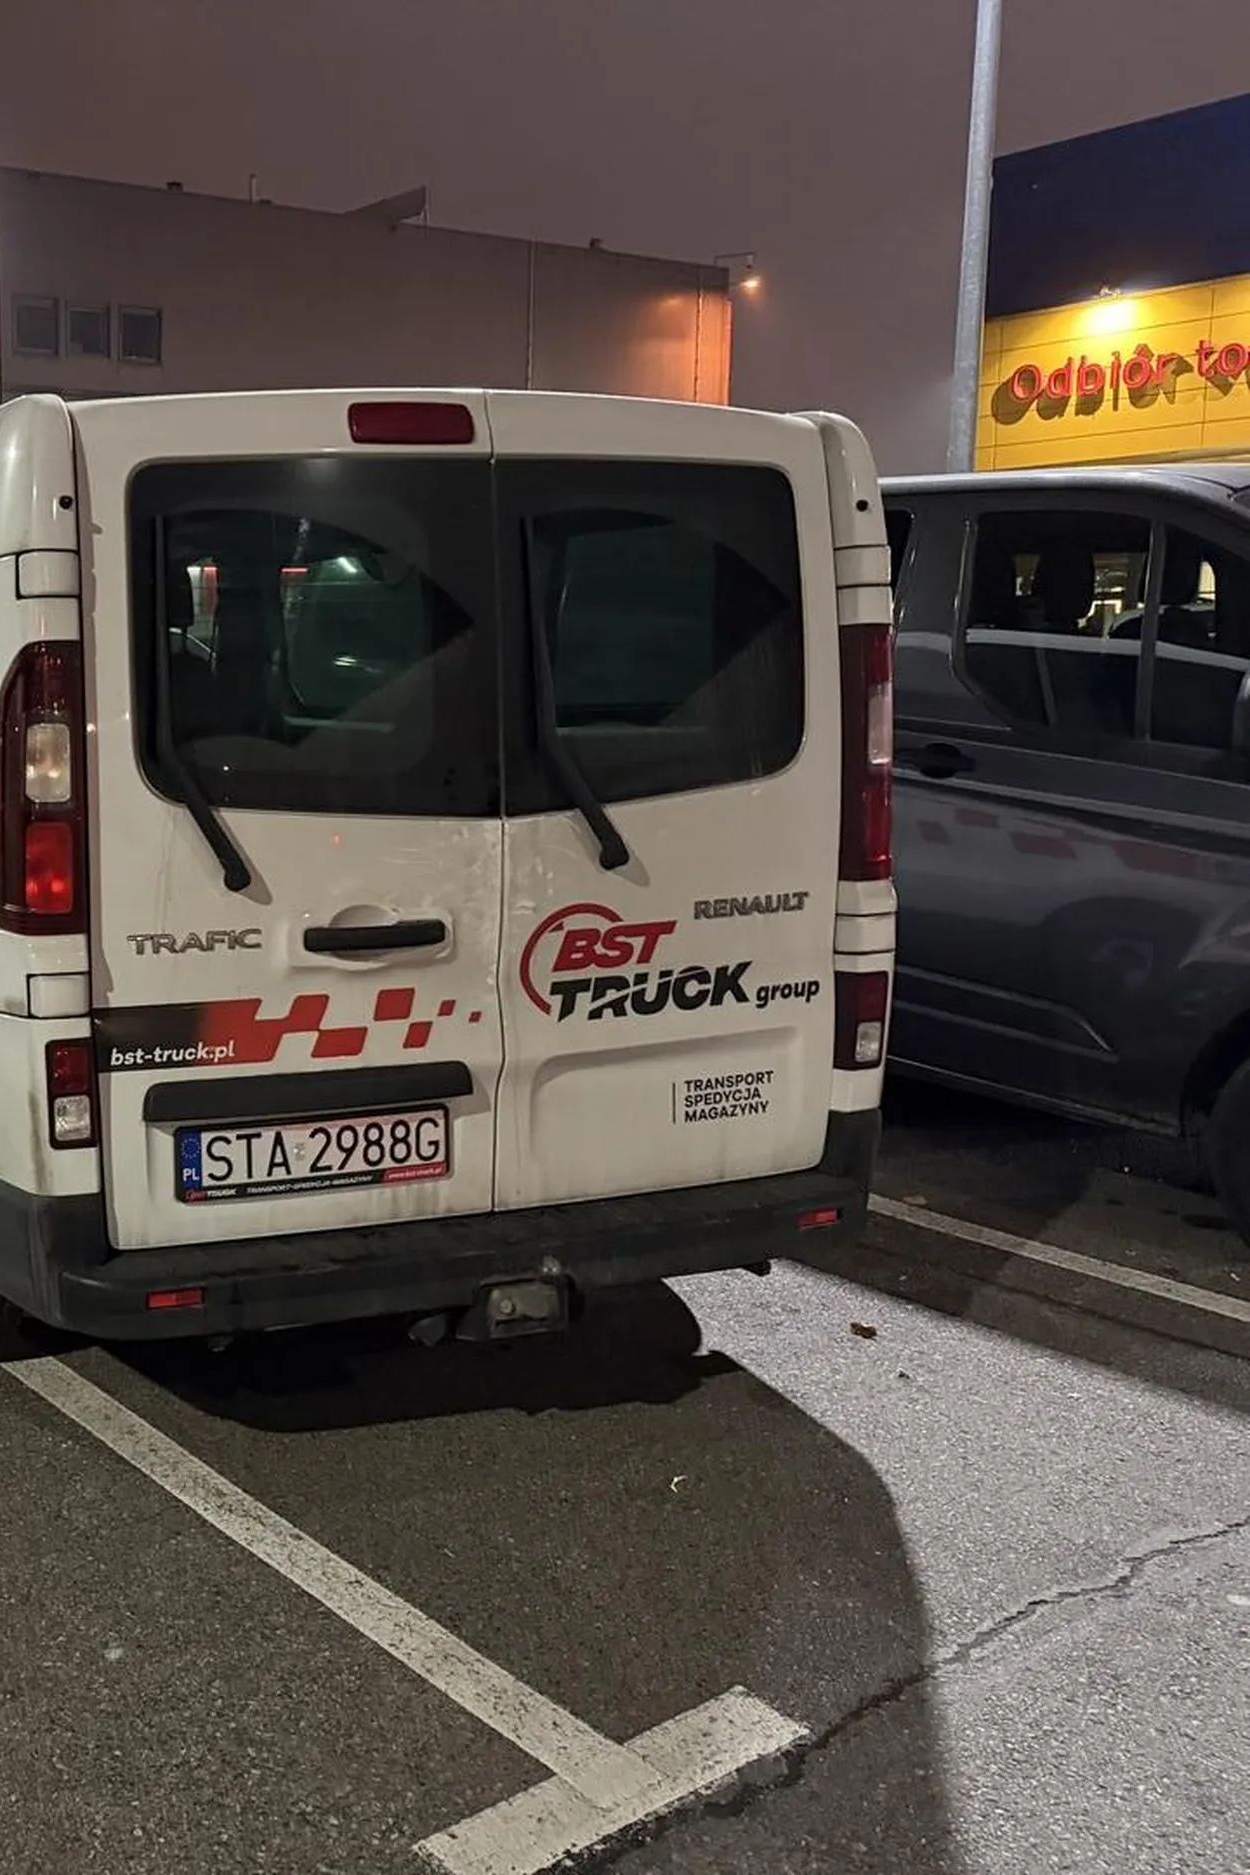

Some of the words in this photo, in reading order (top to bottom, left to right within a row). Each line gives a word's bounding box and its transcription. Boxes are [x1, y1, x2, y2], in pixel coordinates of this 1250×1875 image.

[1196, 340, 1250, 380] to
[693, 892, 810, 919] RENAULT
[127, 928, 262, 955] TRAFIC
[552, 920, 678, 973] BST
[550, 961, 754, 1023] TRUCK
[756, 980, 821, 1009] group
[110, 1040, 235, 1067] bst-truck.pl
[684, 1071, 775, 1093] TRANSPORT
[684, 1087, 762, 1109] SPEDYCJA
[684, 1101, 770, 1123] MAGAZYNY
[206, 1130, 292, 1182] STA
[309, 1117, 440, 1173] 2988G
[183, 1168, 200, 1181] PL
